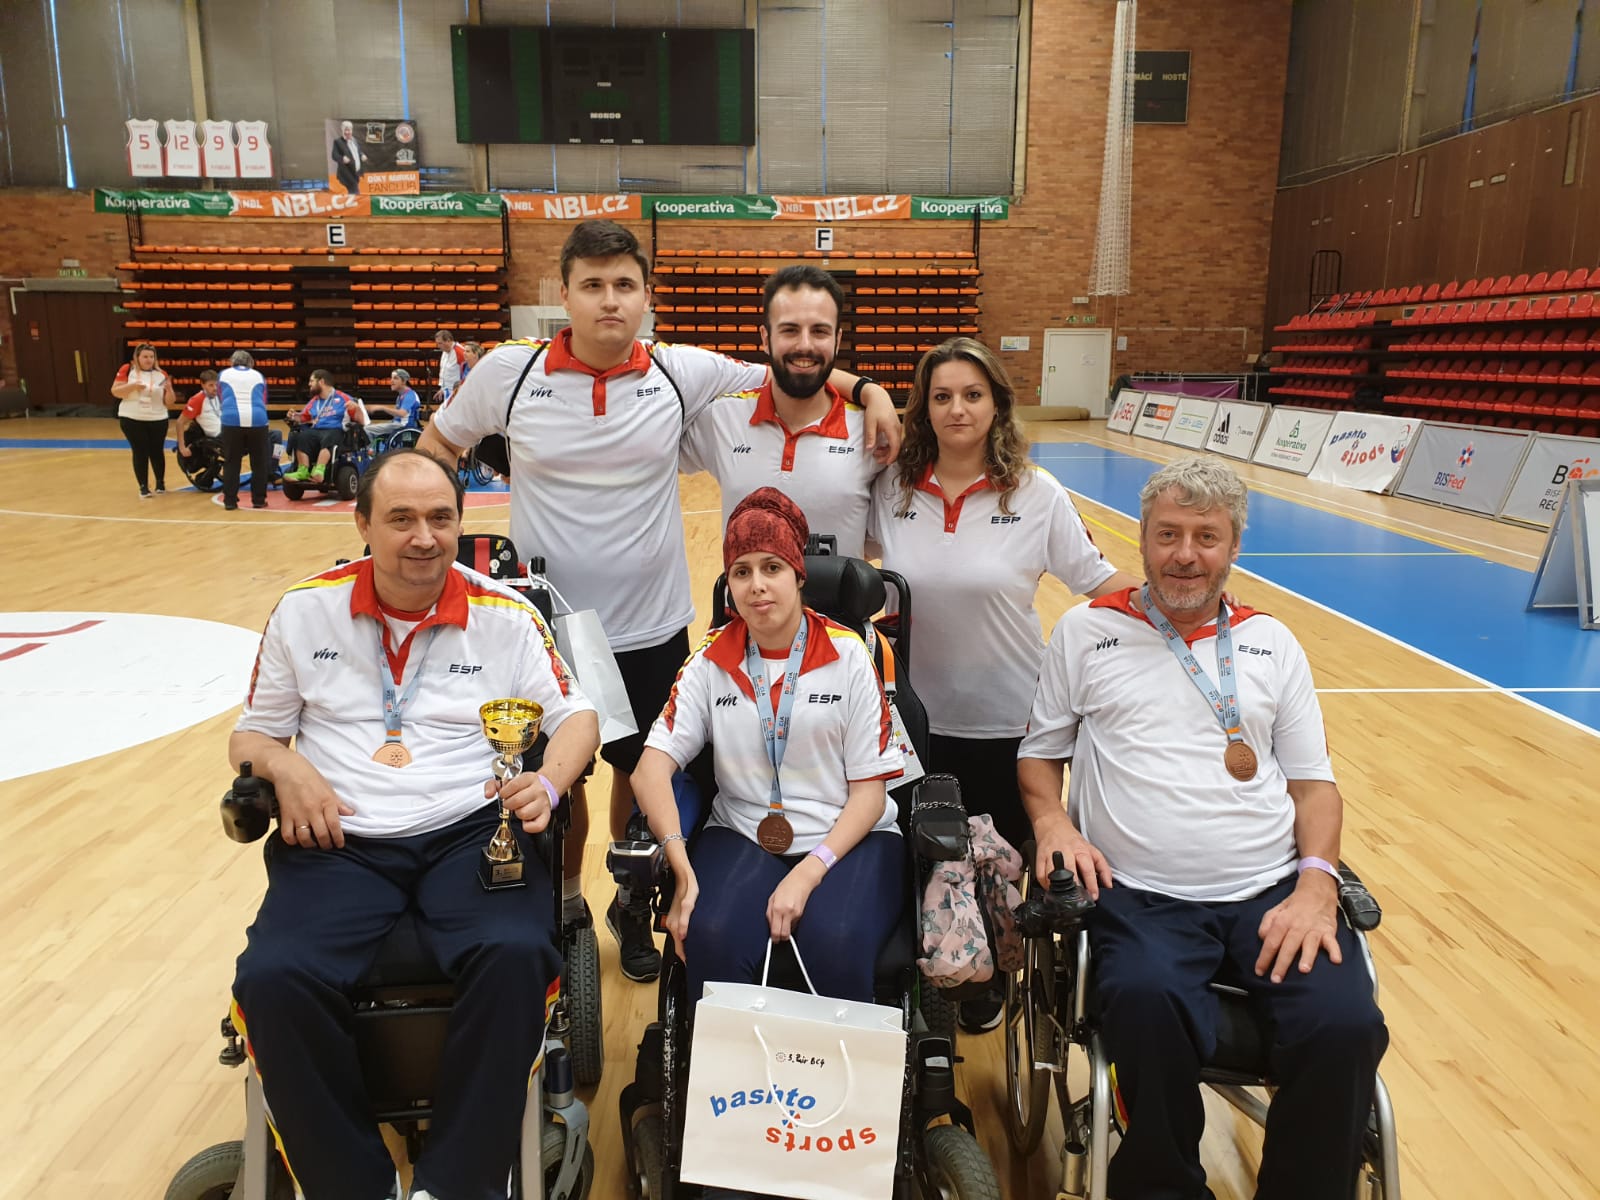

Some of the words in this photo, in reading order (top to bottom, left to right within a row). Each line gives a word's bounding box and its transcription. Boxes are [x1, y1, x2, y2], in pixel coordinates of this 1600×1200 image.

[140, 134, 150, 150] 5
[174, 135, 189, 150] 12
[213, 135, 224, 150] 9
[247, 135, 259, 150] 9
[242, 199, 263, 209] NBL
[379, 197, 464, 212] Kooperativa
[514, 202, 534, 211] NBL
[785, 203, 805, 213] NBL
[329, 226, 344, 244] E
[818, 229, 831, 248] F
[636, 387, 661, 397] ESP
[829, 445, 855, 454] ESP
[1433, 471, 1467, 491] BISFed
[991, 516, 1021, 524] ESP
[1238, 644, 1272, 657] ESP
[449, 663, 482, 675] ESP
[808, 694, 842, 705] ESP
[710, 1084, 816, 1117] bashto
[765, 1126, 877, 1153] sports
